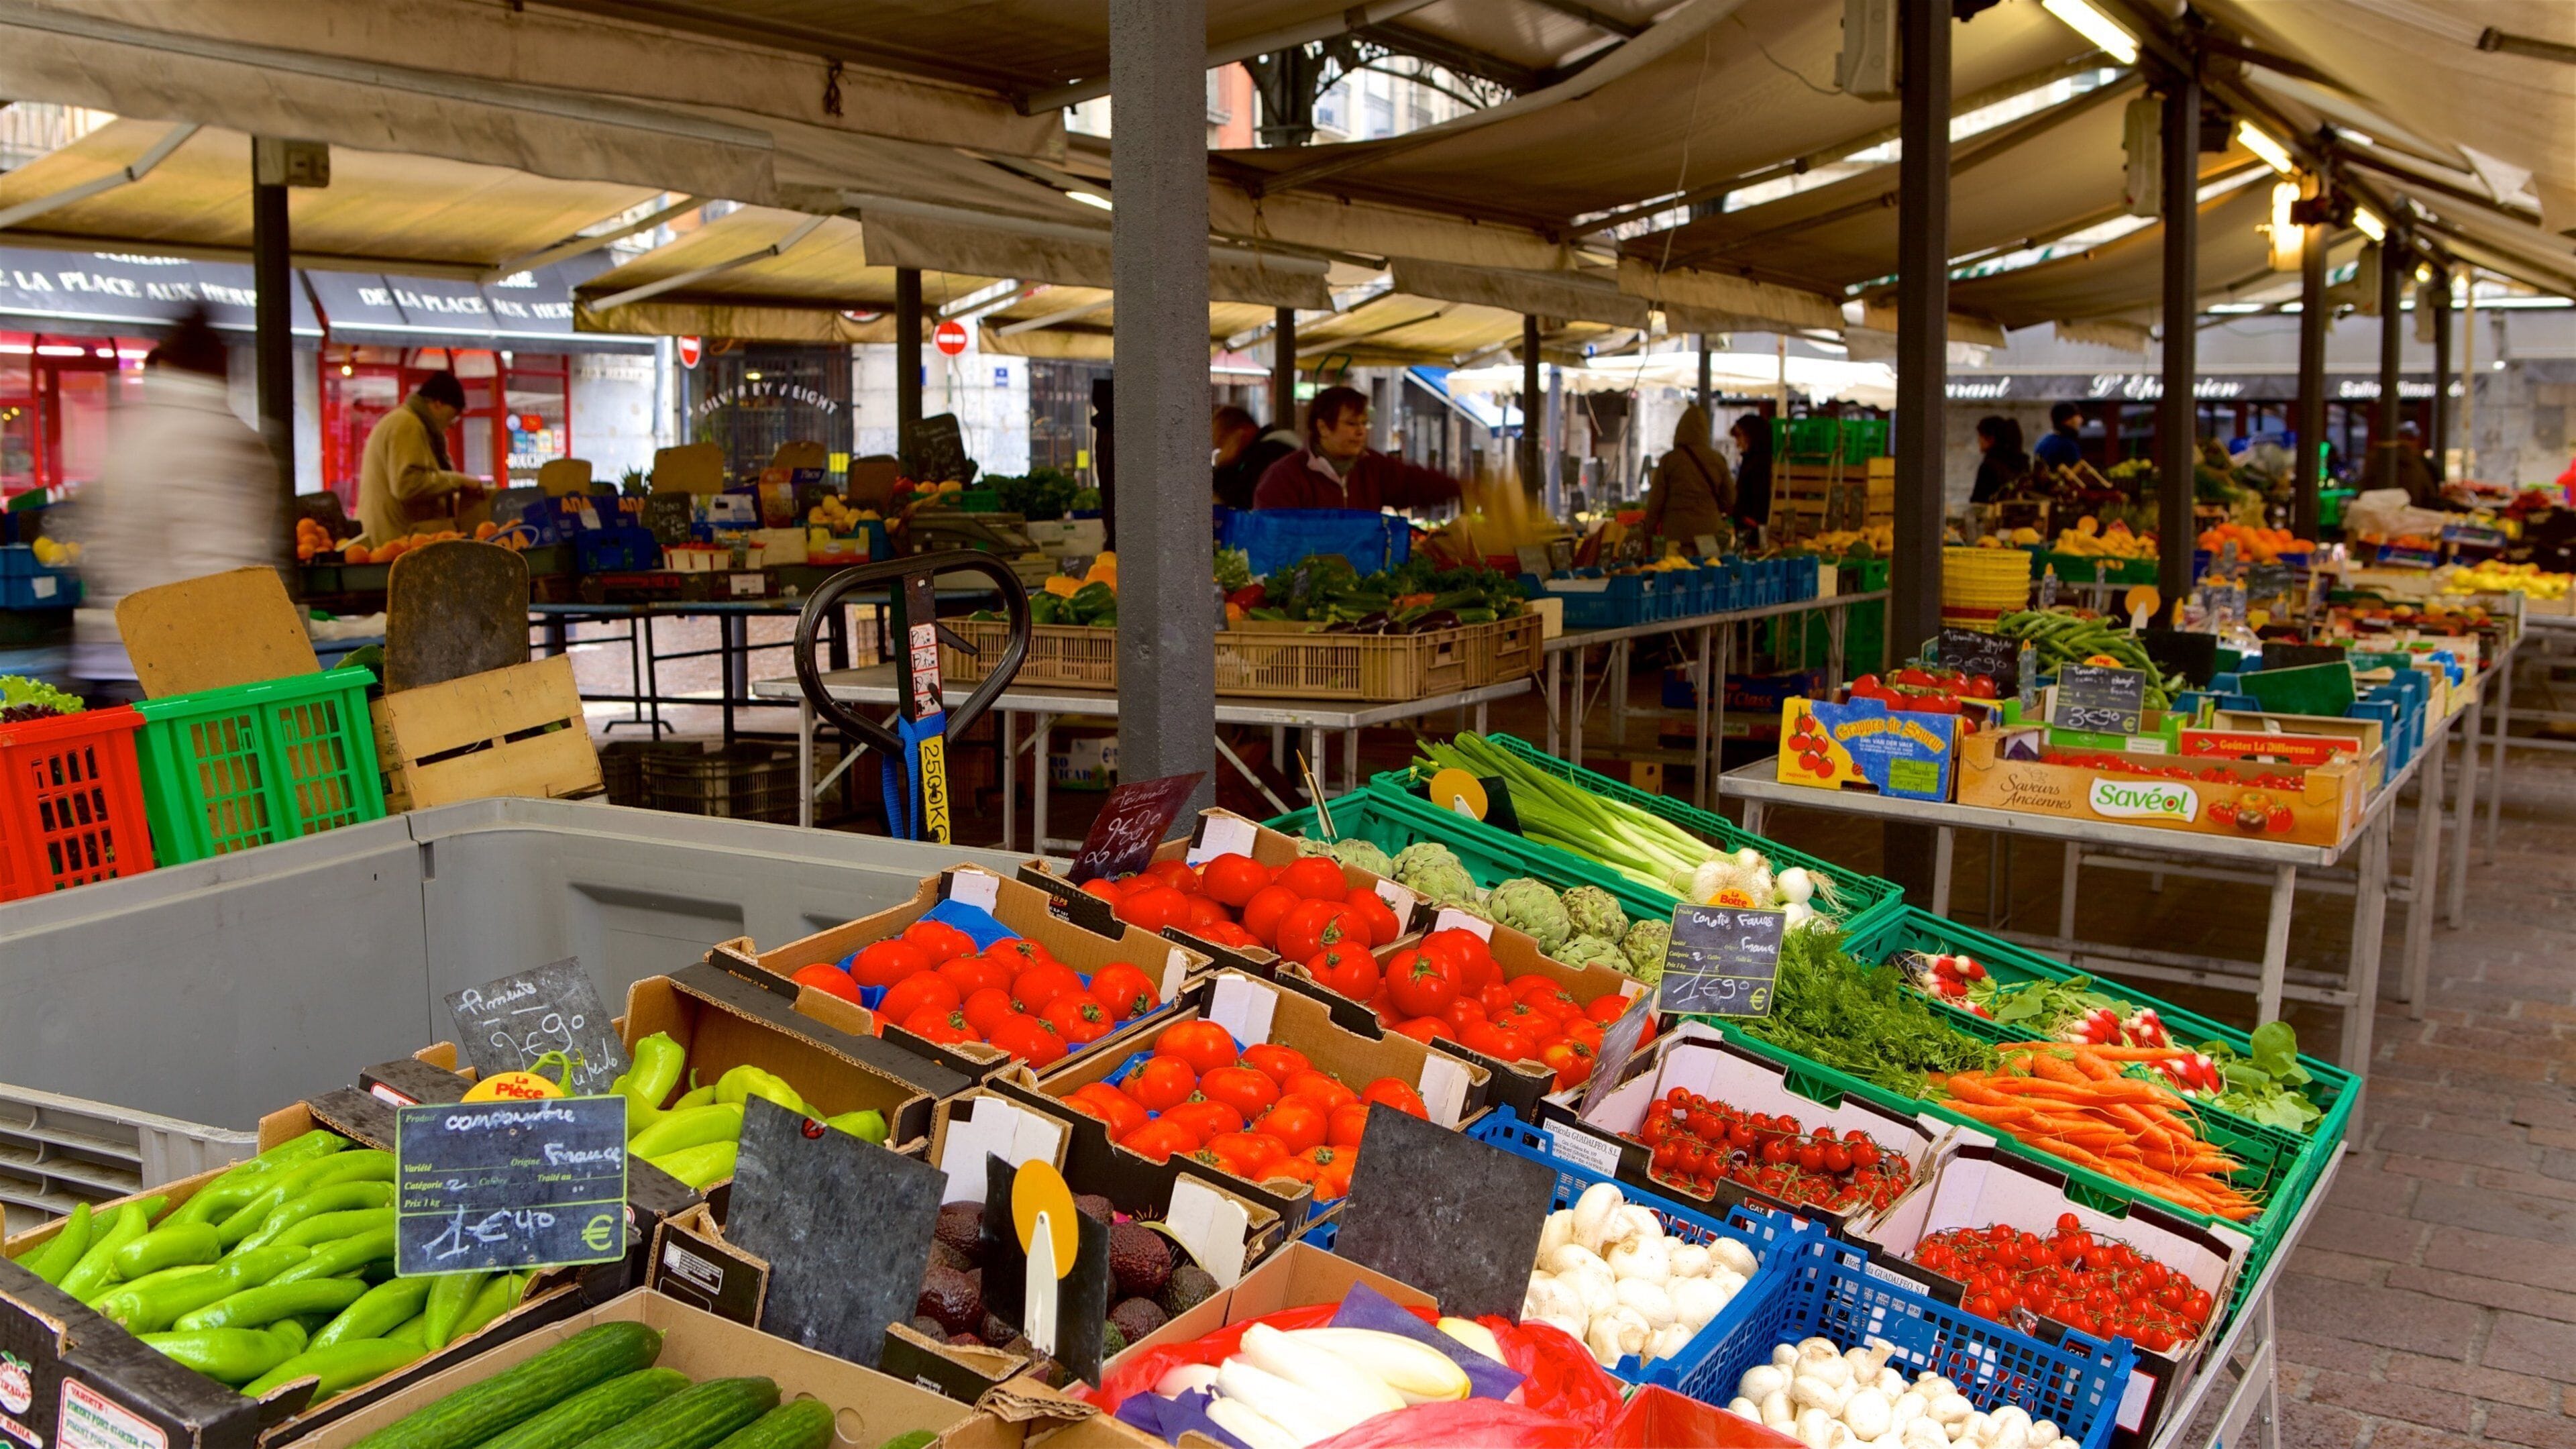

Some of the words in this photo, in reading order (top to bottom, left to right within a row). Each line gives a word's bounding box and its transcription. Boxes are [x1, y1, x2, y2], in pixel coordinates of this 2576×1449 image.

[13, 270, 53, 292] LA
[58, 272, 142, 299] PLACE
[146, 282, 197, 301] AUX
[358, 288, 391, 306] DE
[393, 289, 420, 307] LA
[421, 294, 488, 313] PLACE
[492, 299, 529, 318] AUX
[532, 302, 573, 319] HER
[2068, 706, 2121, 727] 3€90
[1835, 719, 1885, 741] Grappes
[1886, 717, 1902, 733] de
[1902, 720, 1946, 753] Saveur
[2000, 773, 2061, 795] Saveurs
[1998, 792, 2072, 810] Anciennes
[2096, 783, 2189, 814] Savéol
[1720, 895, 1748, 907] Botte
[1672, 965, 1750, 1004] 1€90
[1749, 987, 1767, 1011] €
[495, 1083, 544, 1099] Pièce
[515, 1076, 528, 1085] La
[405, 1114, 436, 1123] Produit
[405, 1163, 431, 1173] Variété
[511, 1158, 540, 1168] Origine
[544, 1142, 622, 1166] France
[404, 1181, 443, 1193] Catégorie
[446, 1179, 467, 1192] 2
[537, 1173, 561, 1182] Traité
[404, 1199, 421, 1208] Prix
[430, 1197, 440, 1208] kg
[1749, 1204, 1765, 1215] CAT.
[422, 1203, 555, 1261] 1€40
[581, 1214, 614, 1252] €
[6, 1419, 31, 1440] BAHA
